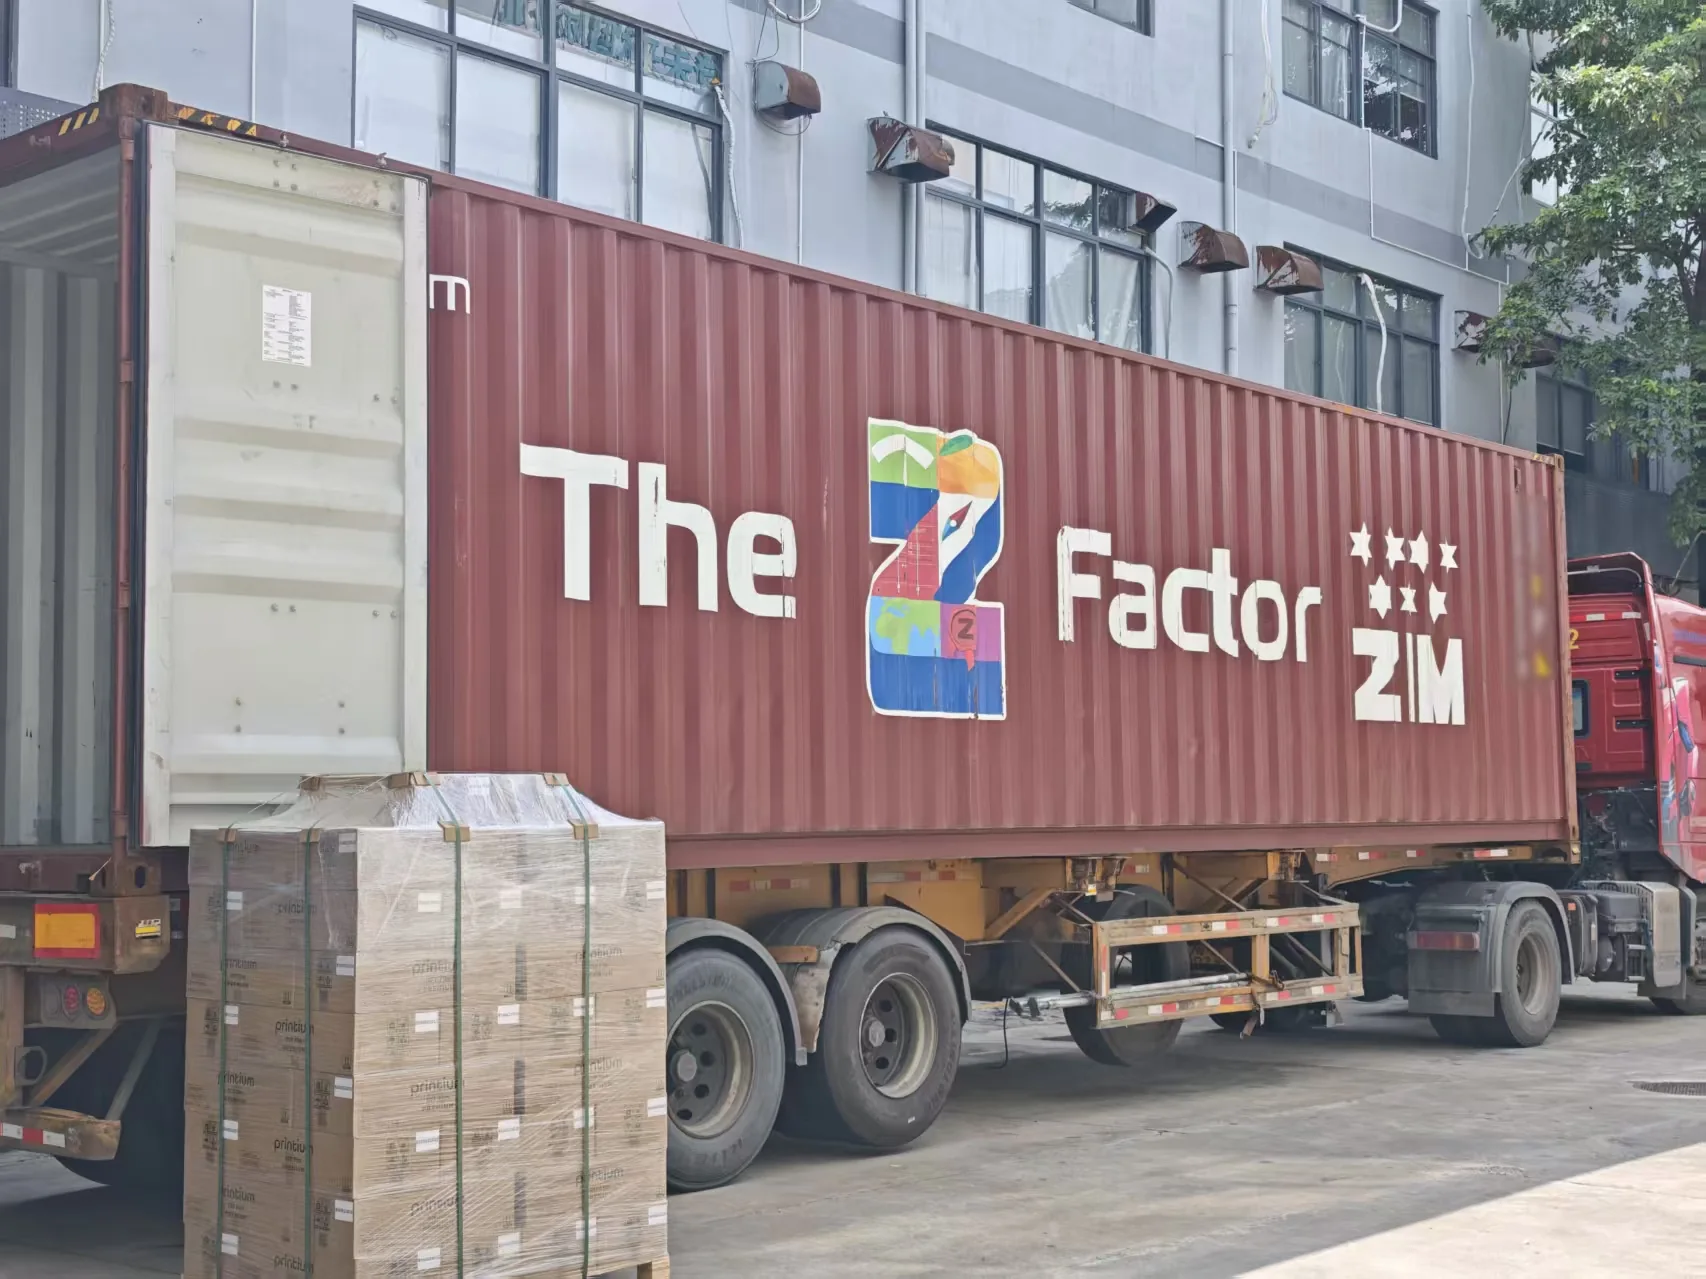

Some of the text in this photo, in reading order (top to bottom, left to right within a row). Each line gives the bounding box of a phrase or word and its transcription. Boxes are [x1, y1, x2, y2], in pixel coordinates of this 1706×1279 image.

[520, 442, 797, 619] The
[1057, 526, 1322, 662] Factor
[1352, 627, 1466, 726] ZIM
